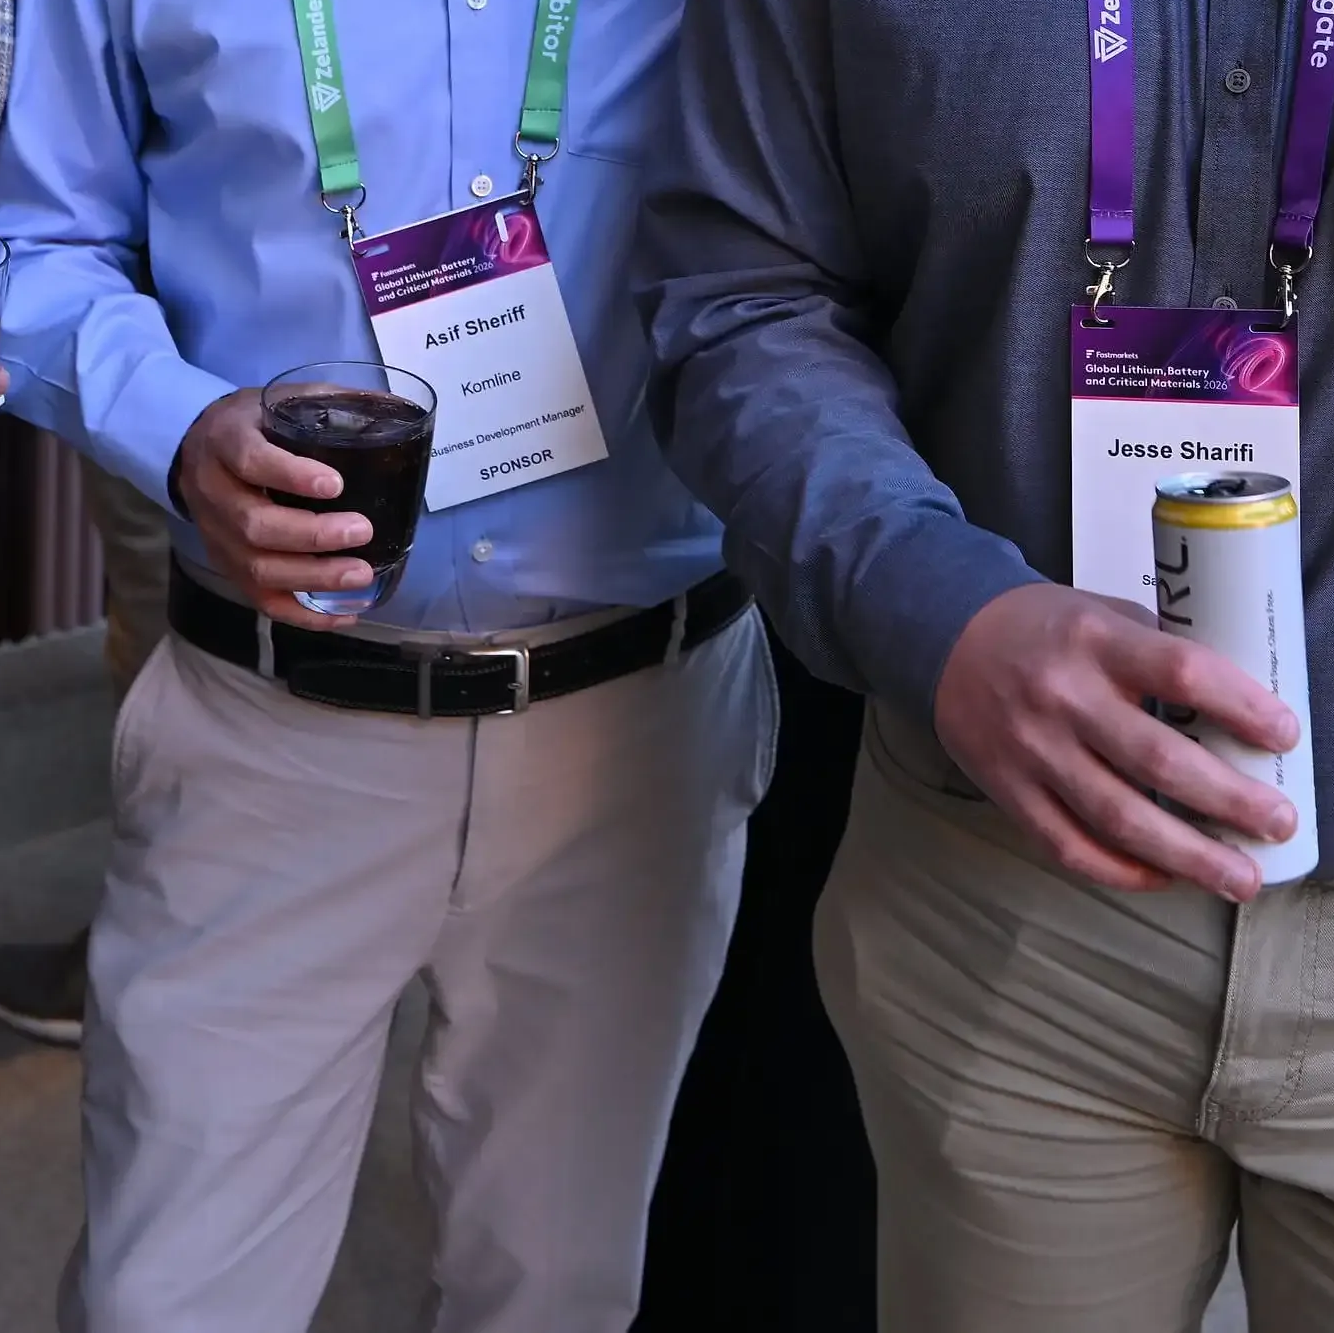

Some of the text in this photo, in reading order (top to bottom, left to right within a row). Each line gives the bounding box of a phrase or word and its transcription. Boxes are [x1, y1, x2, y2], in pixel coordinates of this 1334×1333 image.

[375, 256, 476, 292] Global Lithium, Battery
[378, 261, 494, 303] and Critical Materials 2026
[380, 263, 416, 278] Fastmarkets
[425, 304, 526, 350] Asif Sheriff
[1096, 351, 1139, 360] Fastmarkets
[461, 370, 522, 397] Komline
[1085, 364, 1210, 379] Global Lithium, Battery
[1085, 377, 1228, 391] and Critical Materials 2026
[431, 404, 585, 458] Business Development Manager
[1107, 438, 1254, 462] Jesse Sharifi
[480, 449, 554, 481] SPONSOR
